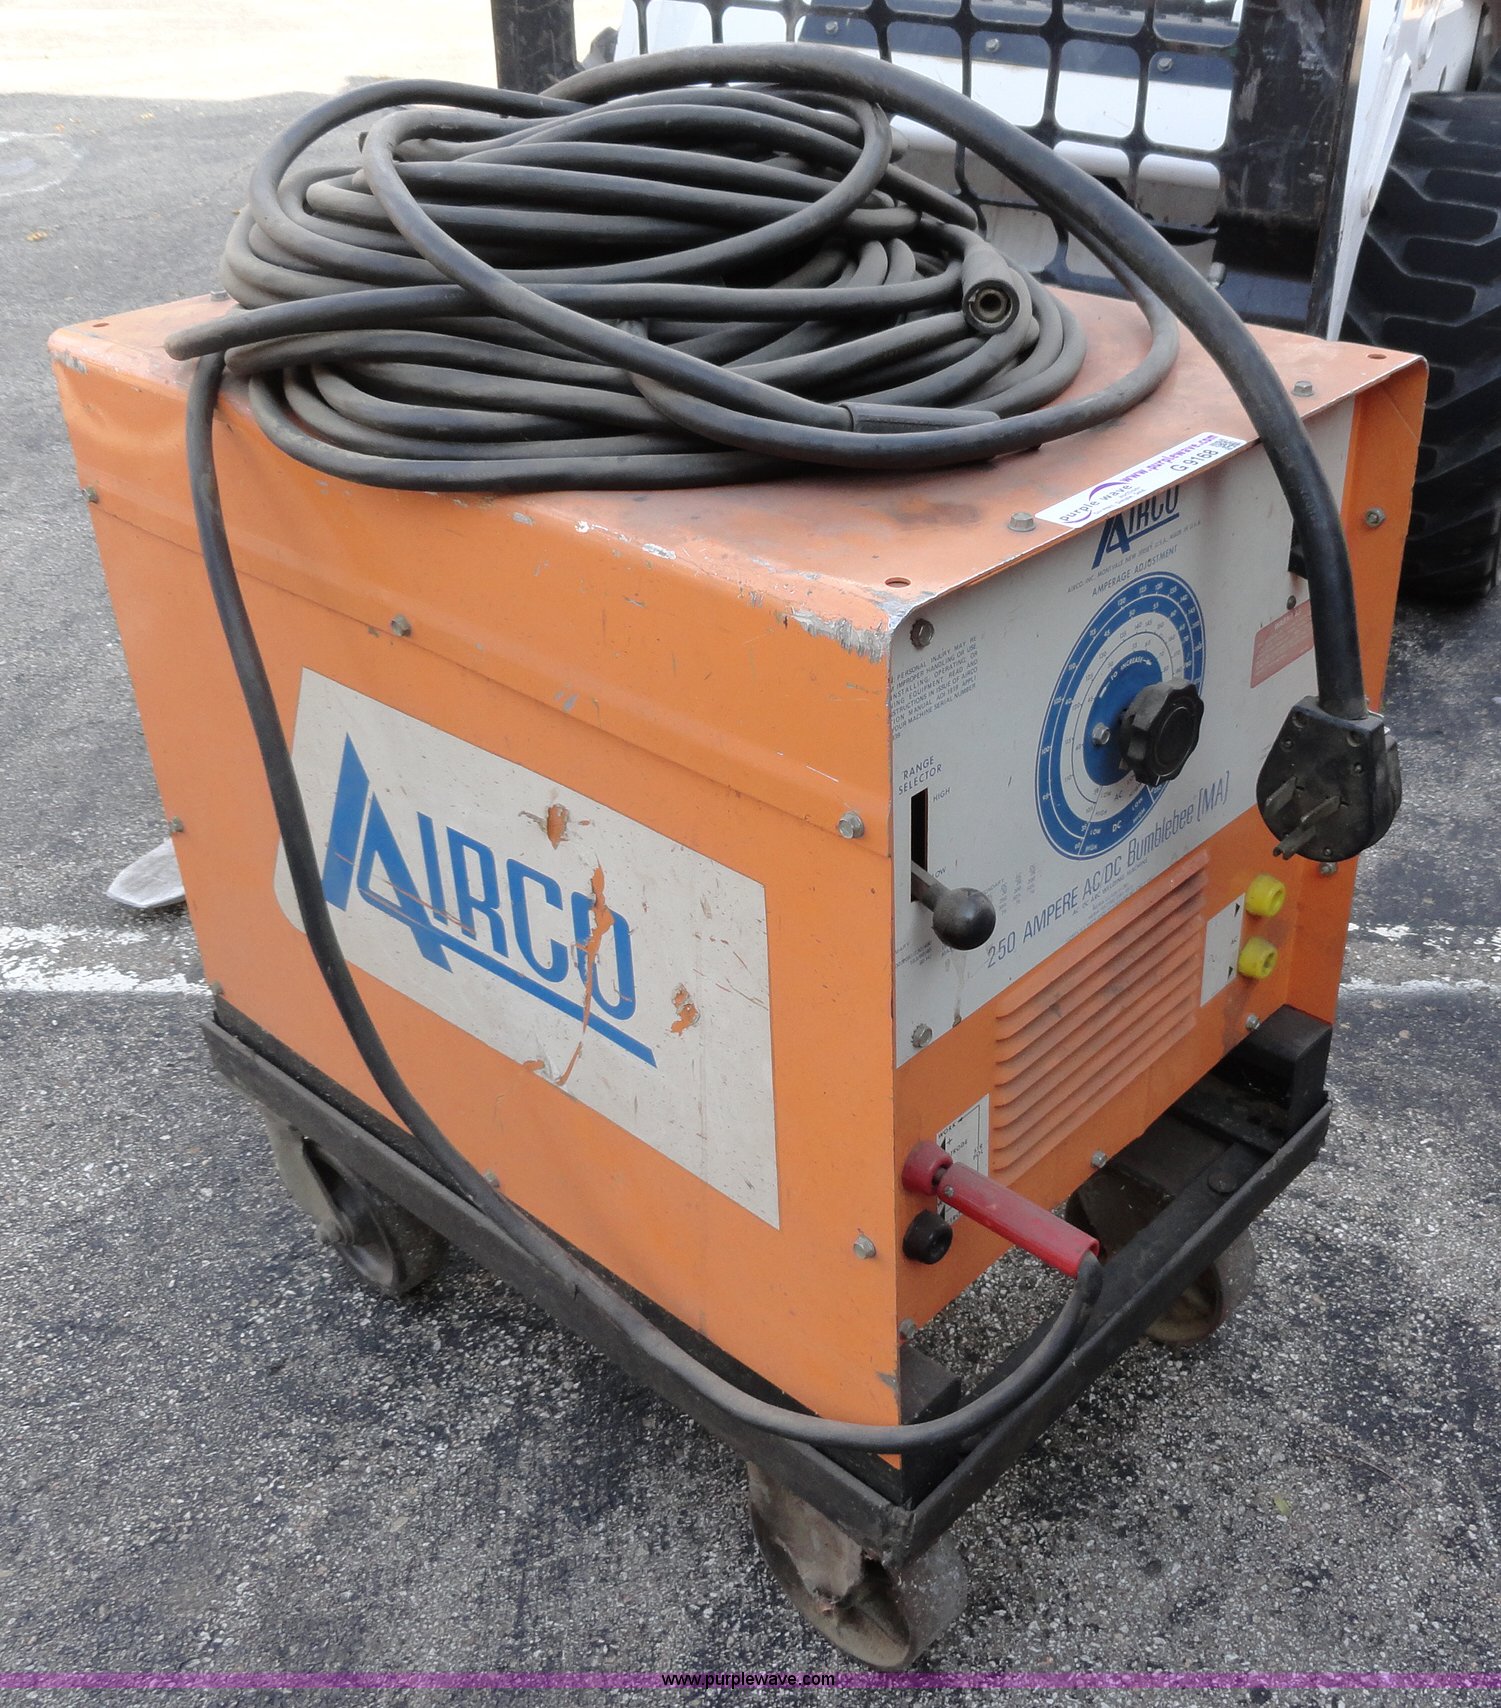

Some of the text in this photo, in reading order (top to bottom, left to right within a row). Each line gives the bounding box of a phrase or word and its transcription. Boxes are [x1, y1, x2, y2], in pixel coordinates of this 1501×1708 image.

[1121, 434, 1217, 483] www.purplewave.com
[1170, 449, 1219, 473] G 9168
[1059, 500, 1100, 523] purple
[1099, 483, 1133, 501] wave
[1091, 485, 1179, 570] AIRCO
[1092, 545, 1178, 597] AMPERAGE ADJUSTMENT
[896, 644, 977, 690] IMPROPER HANDLING OR USE
[897, 662, 927, 680] PERSONAL
[954, 642, 967, 652] MAY
[970, 651, 978, 659] OR
[1120, 656, 1144, 670] INCREASE
[909, 677, 944, 699] EQUIPMENT
[948, 667, 964, 679] READ
[967, 659, 978, 670] AND
[928, 690, 935, 698] IN
[936, 681, 951, 693] ISSUE
[952, 676, 960, 684] OF
[893, 683, 976, 731] OUR MACHINE SERIAL NUMBER
[908, 700, 932, 716] MANUAL
[898, 764, 942, 795] SELECTOR
[903, 755, 935, 780] RANGE
[933, 787, 951, 803] HIGH
[1114, 789, 1123, 801] AC
[1131, 798, 1143, 812] LOW
[1089, 828, 1102, 836] LOW
[1112, 820, 1122, 833] DC
[322, 732, 654, 1060] AIRCO
[987, 931, 1016, 969] 250
[1022, 886, 1079, 943] AMPERE
[1082, 855, 1122, 899] AC/DC
[1127, 803, 1194, 868] Bumblebee
[938, 1123, 956, 1139] WORK
[950, 1139, 968, 1155] TRODE
